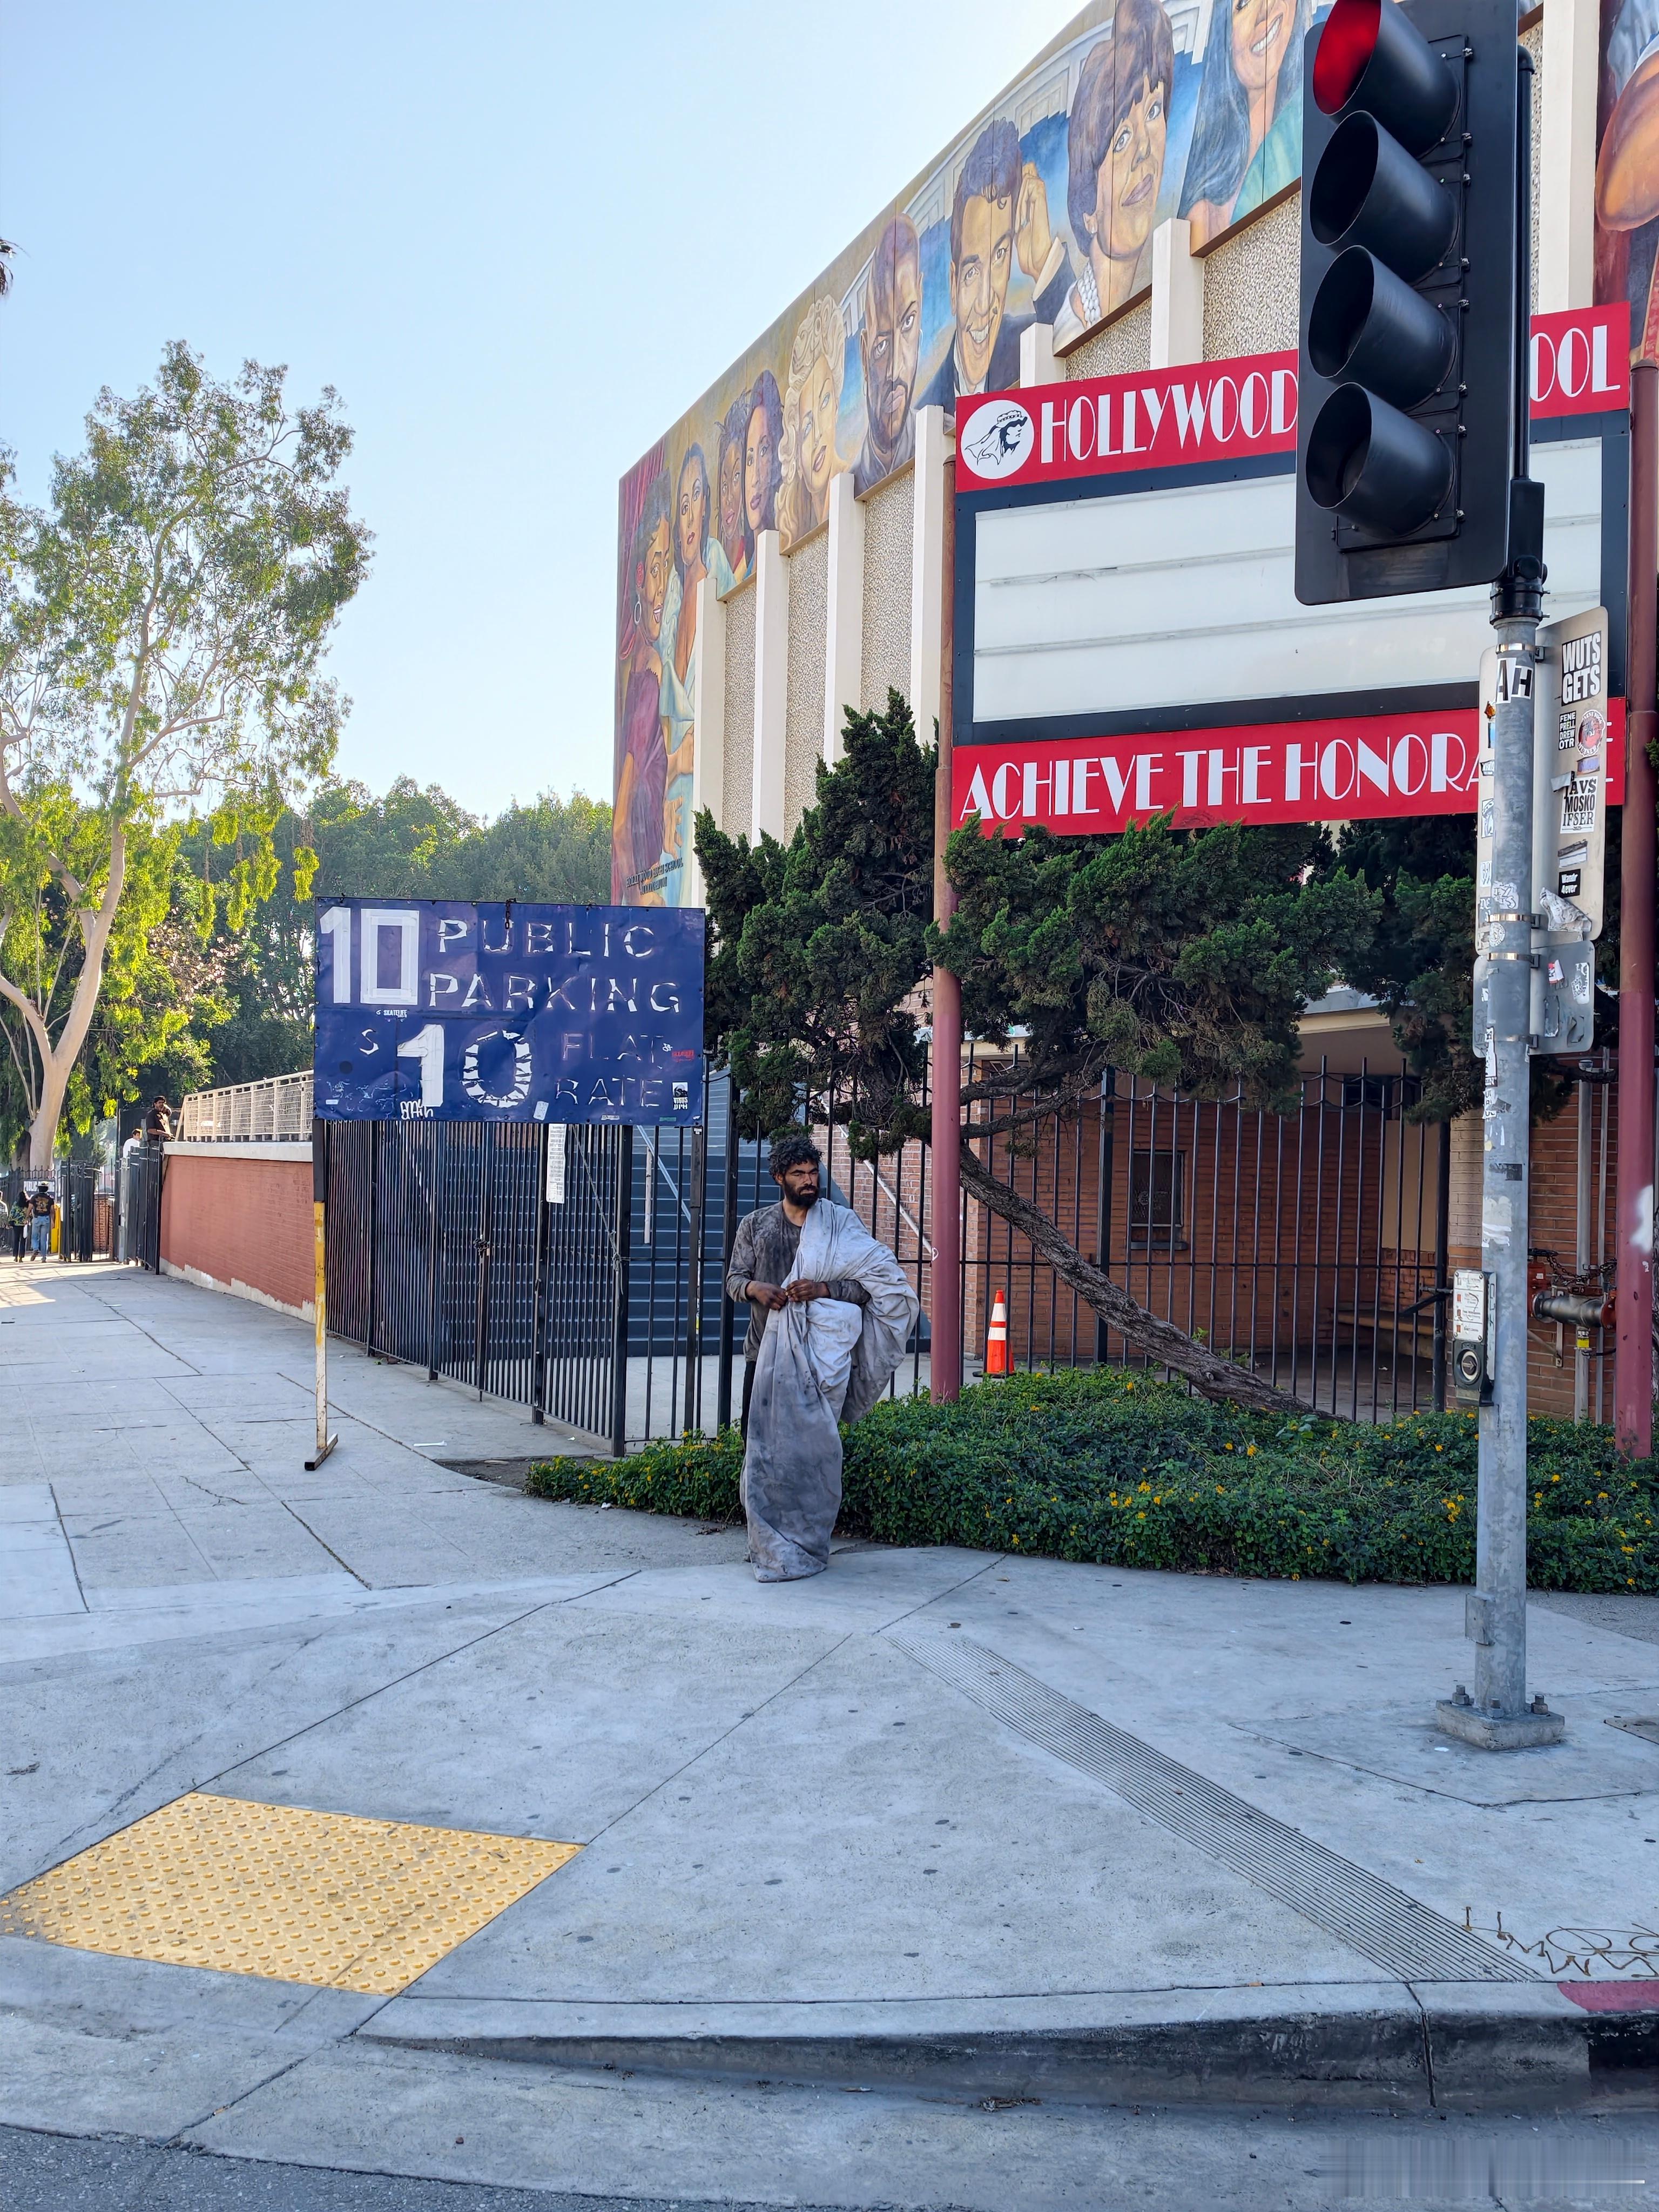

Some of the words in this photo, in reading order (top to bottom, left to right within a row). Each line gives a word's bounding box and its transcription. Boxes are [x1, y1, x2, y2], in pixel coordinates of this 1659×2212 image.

[1040, 369, 1298, 463] HOLLYWOOD
[1529, 325, 1621, 402] OOL
[1562, 632, 1601, 674] WUTS
[1562, 664, 1600, 704] GETS
[1560, 712, 1576, 723] FENE
[1559, 738, 1575, 750] OTR
[960, 753, 1164, 821] ACHIEVE
[1175, 745, 1272, 807] THE
[1285, 733, 1479, 802] HONOR
[1564, 794, 1596, 813] MOSKO
[319, 906, 420, 1006] 10
[437, 919, 655, 958] PUBLIC
[429, 973, 679, 1013] PARKING
[555, 1077, 664, 1107] RATE
